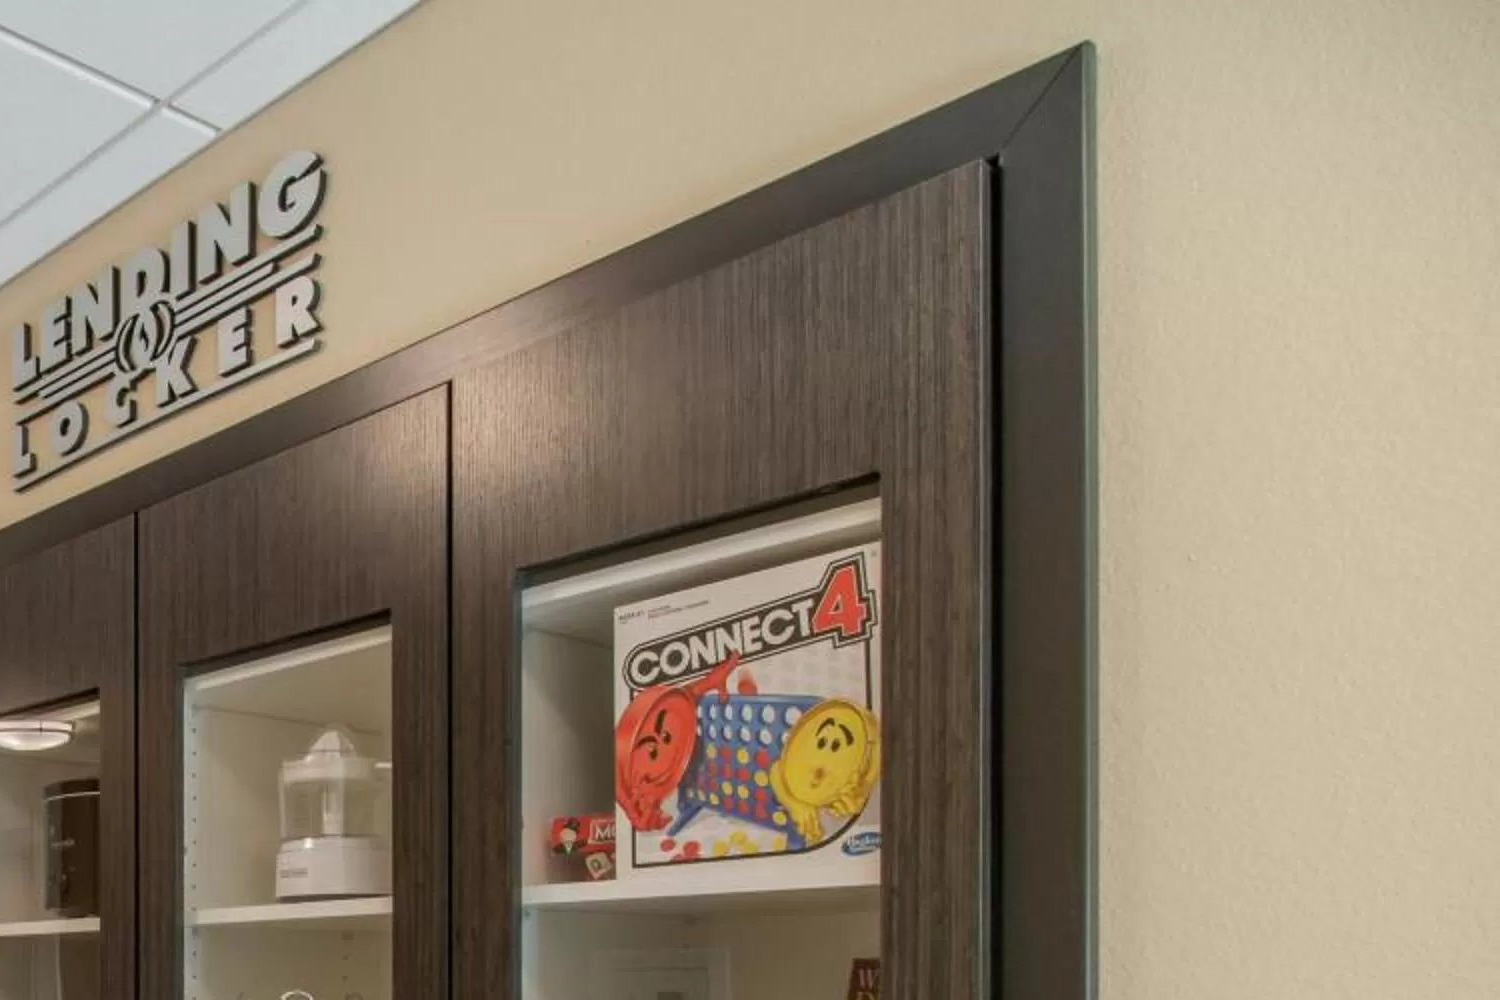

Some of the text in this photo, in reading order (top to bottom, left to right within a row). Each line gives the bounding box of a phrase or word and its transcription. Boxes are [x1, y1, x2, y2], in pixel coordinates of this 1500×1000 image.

[12, 150, 327, 393] LENDING
[13, 274, 324, 478] LOCKER
[629, 563, 868, 684] CONNECT 4
